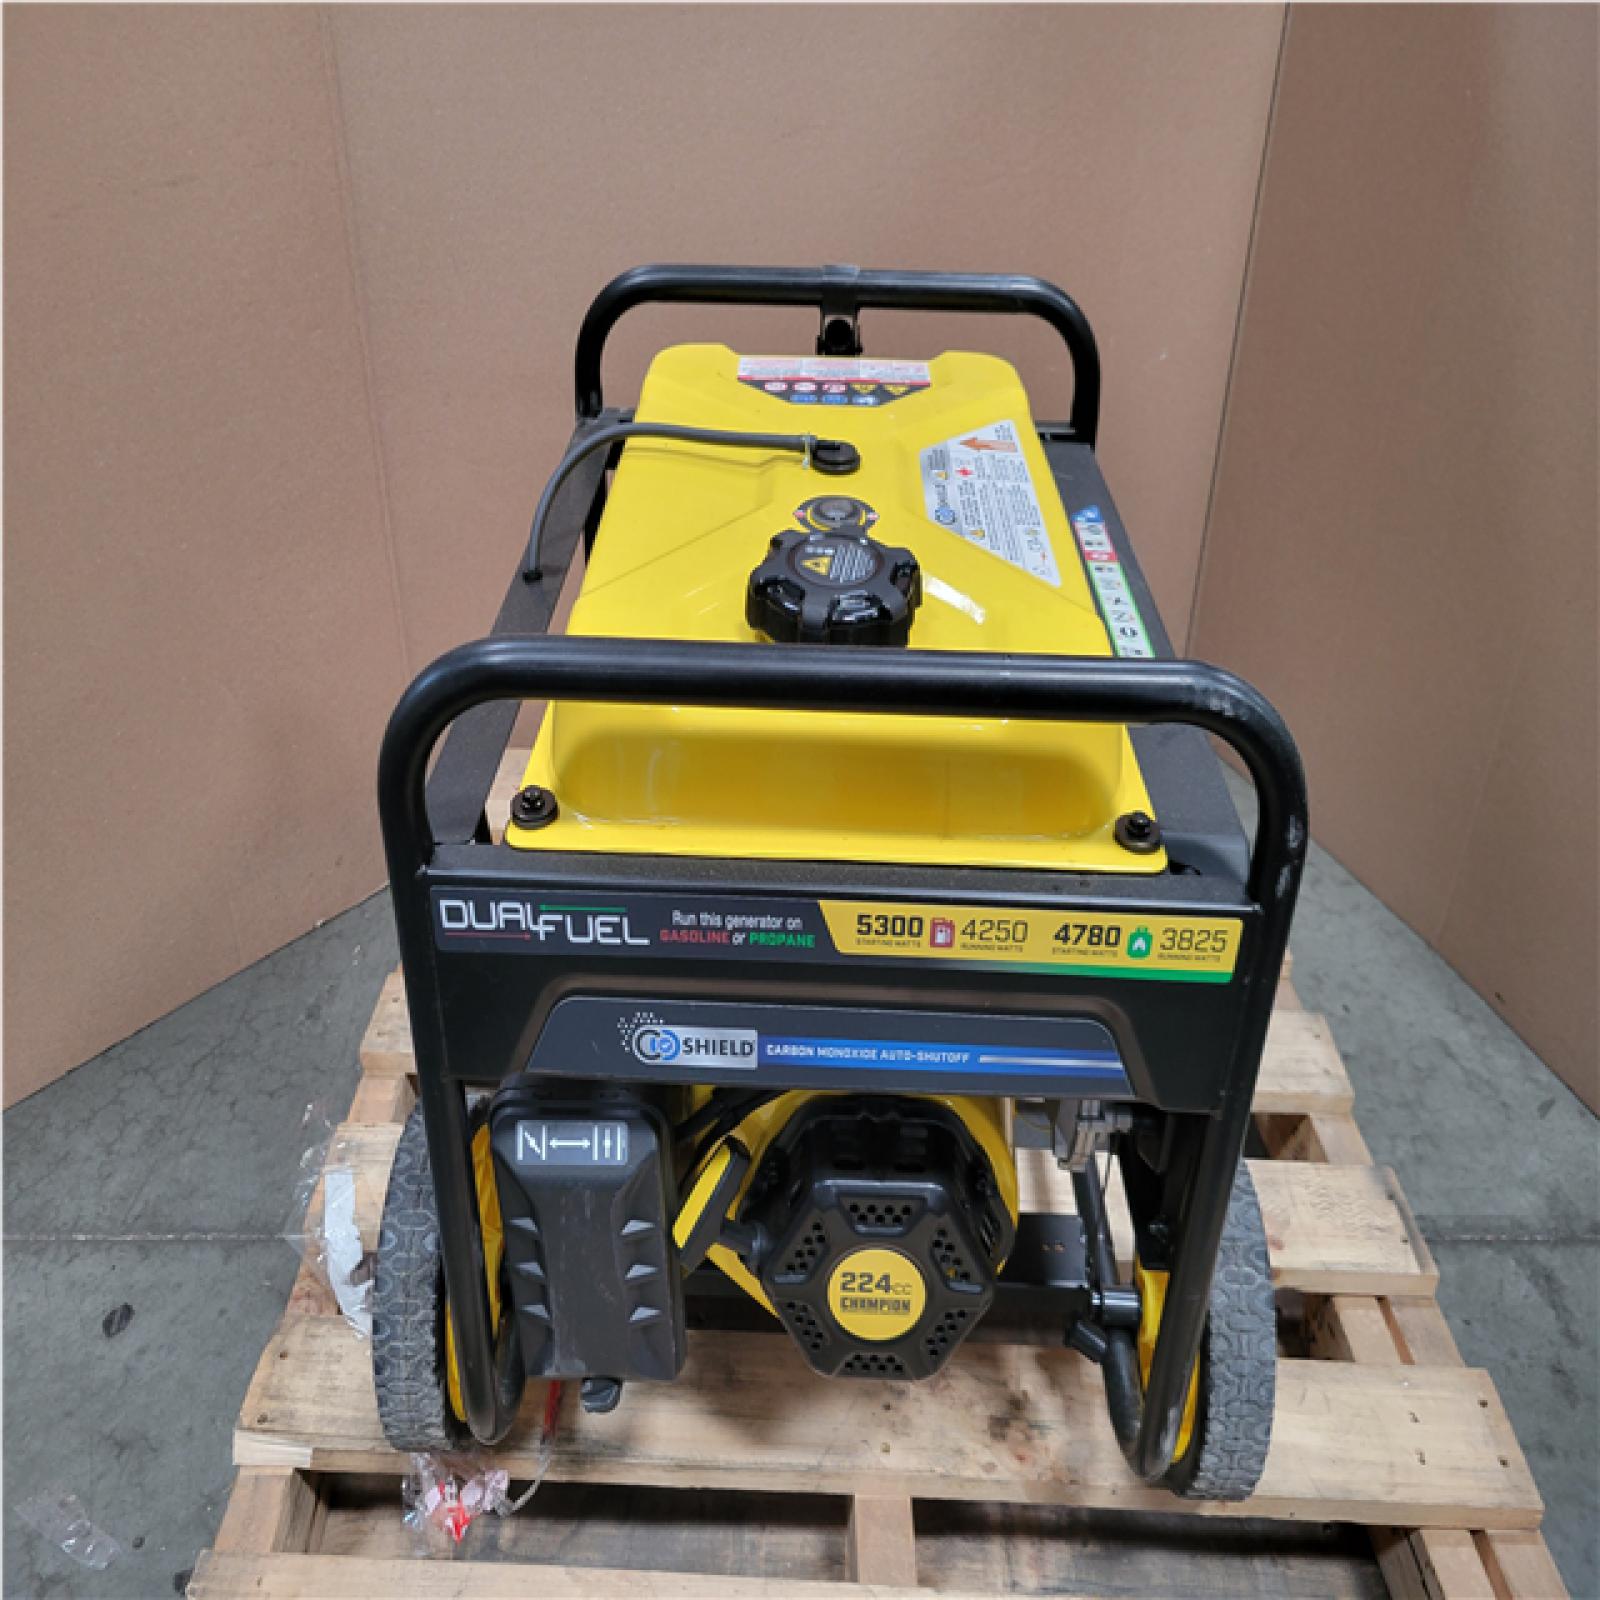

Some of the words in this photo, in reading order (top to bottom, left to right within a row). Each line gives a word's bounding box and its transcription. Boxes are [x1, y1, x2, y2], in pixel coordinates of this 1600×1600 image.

[535, 915, 650, 945] FUEL
[672, 909, 697, 926] Run
[700, 911, 722, 928] this
[725, 914, 783, 931] generator
[786, 916, 804, 930] on
[856, 914, 924, 938] 5300
[960, 919, 1029, 944] 4250
[660, 929, 730, 944] GASOLINE
[731, 932, 746, 946] or
[749, 931, 816, 948] PROPANE
[1053, 922, 1121, 947] 4780
[1159, 926, 1229, 953] 3825
[682, 1036, 755, 1056] SHIELD
[766, 1044, 815, 1056] CARBON
[817, 1046, 878, 1060] MONOXIDE
[879, 1048, 970, 1063] AUTO-SHUTOFF
[841, 1297, 911, 1314] CHAMPION
